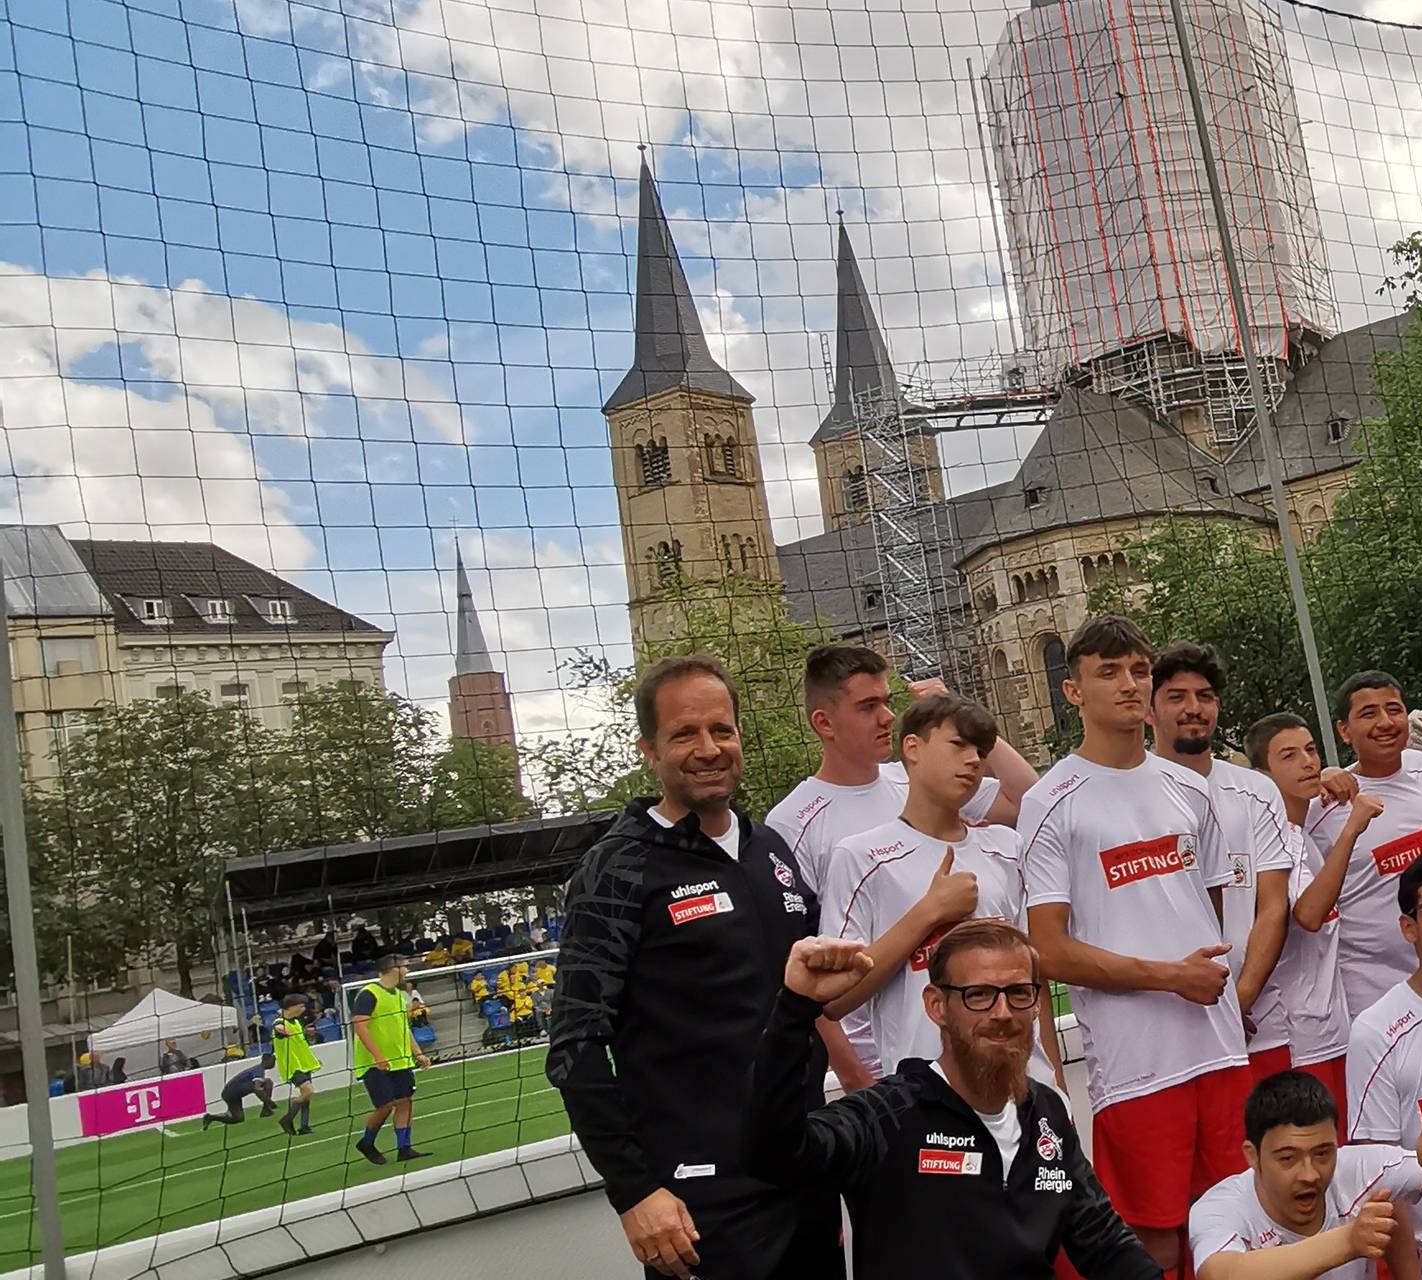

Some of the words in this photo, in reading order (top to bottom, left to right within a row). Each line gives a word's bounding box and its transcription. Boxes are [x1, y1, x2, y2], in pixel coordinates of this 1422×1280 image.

[796, 795, 825, 820] uhsport
[1380, 847, 1422, 870] STIFTU
[671, 880, 720, 899] uhlsport
[674, 903, 716, 921] STIFTUNG
[125, 1086, 161, 1122] T
[926, 1132, 976, 1148] uhlsport
[921, 1158, 961, 1170] STIFTUNG
[1038, 1166, 1066, 1180] Rhein
[1035, 1177, 1072, 1193] Energie
